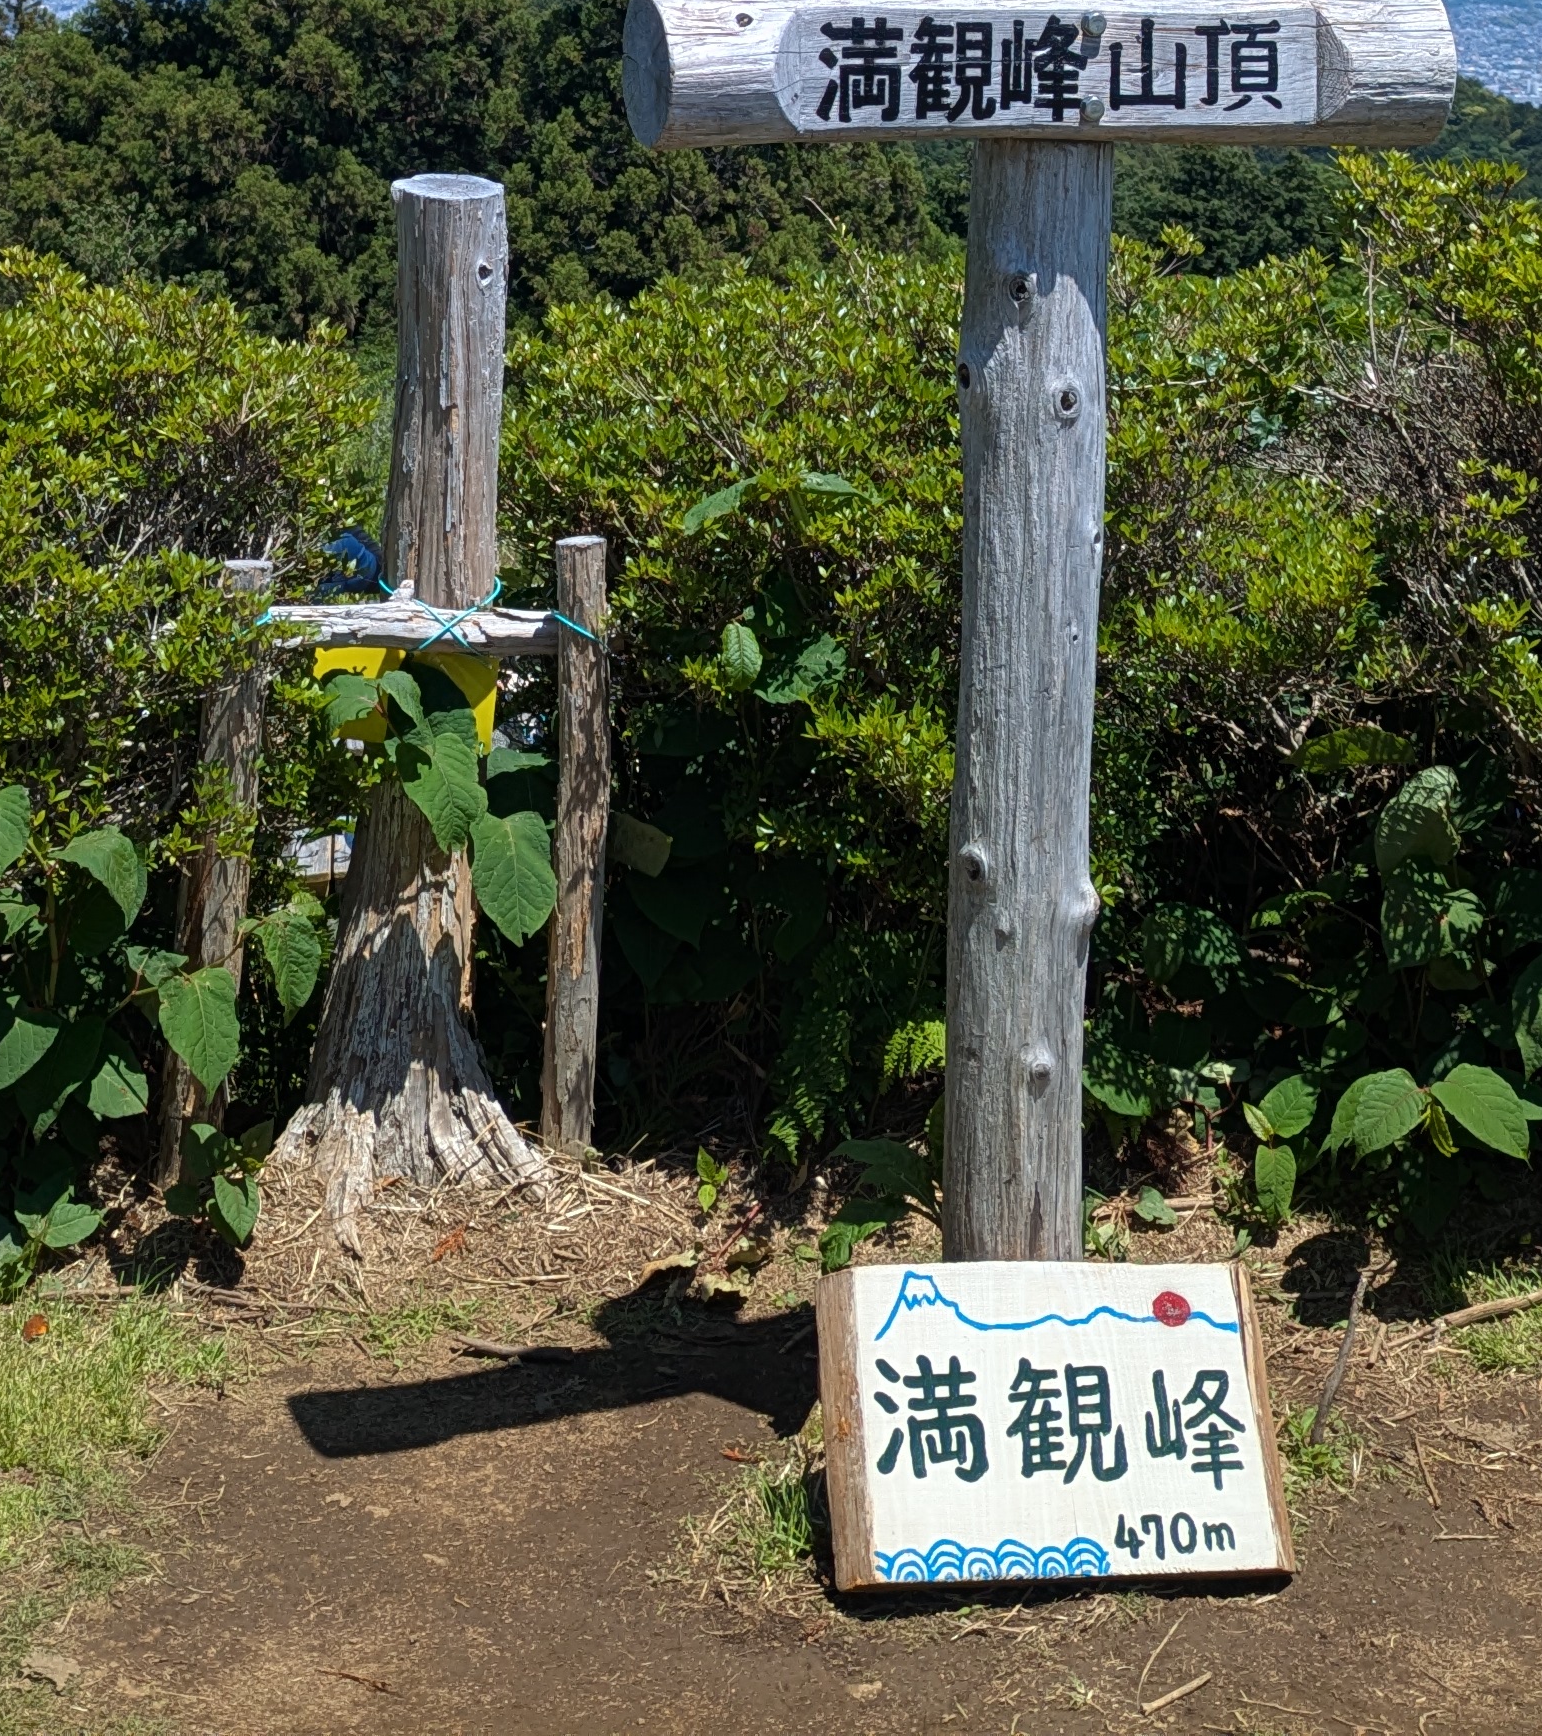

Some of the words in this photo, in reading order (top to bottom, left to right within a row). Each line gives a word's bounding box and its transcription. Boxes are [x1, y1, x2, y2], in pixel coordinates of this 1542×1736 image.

[816, 16, 1282, 122] 満観峰山頂
[874, 1355, 1245, 1490] 満観峰
[1115, 1512, 1236, 1560] 470m
